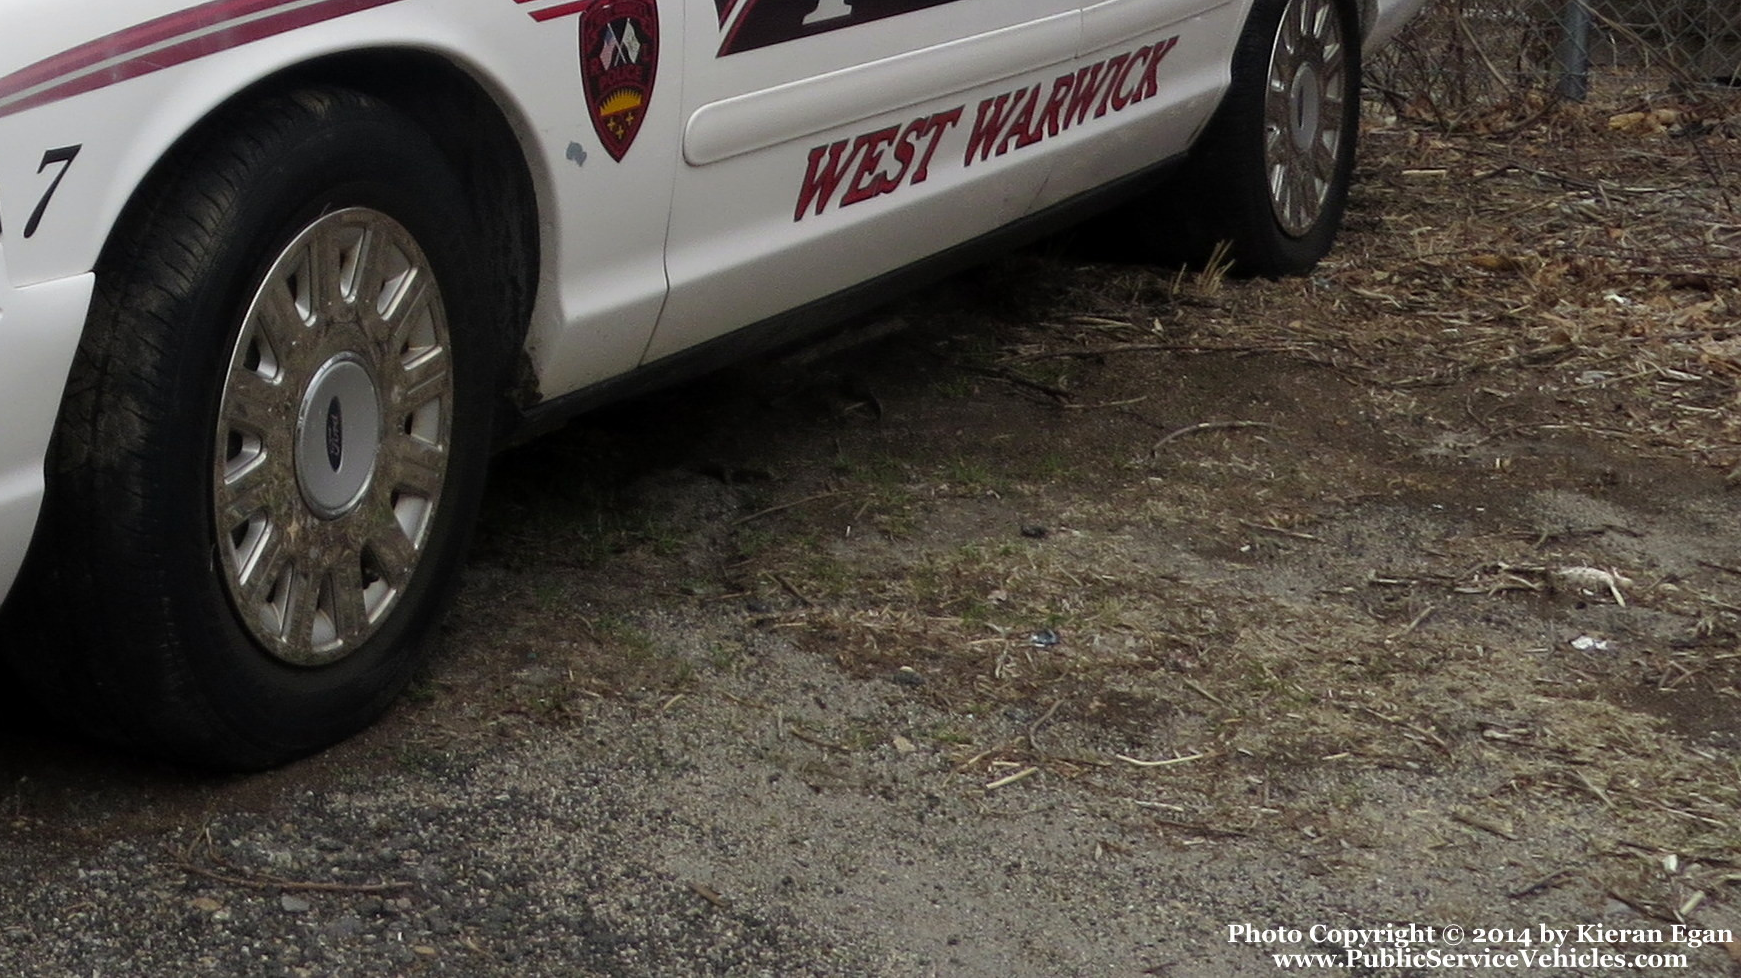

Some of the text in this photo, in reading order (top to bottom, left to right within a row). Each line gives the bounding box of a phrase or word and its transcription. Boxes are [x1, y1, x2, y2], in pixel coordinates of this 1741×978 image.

[23, 143, 83, 239] 7
[793, 35, 1180, 222] WEST WARWICK
